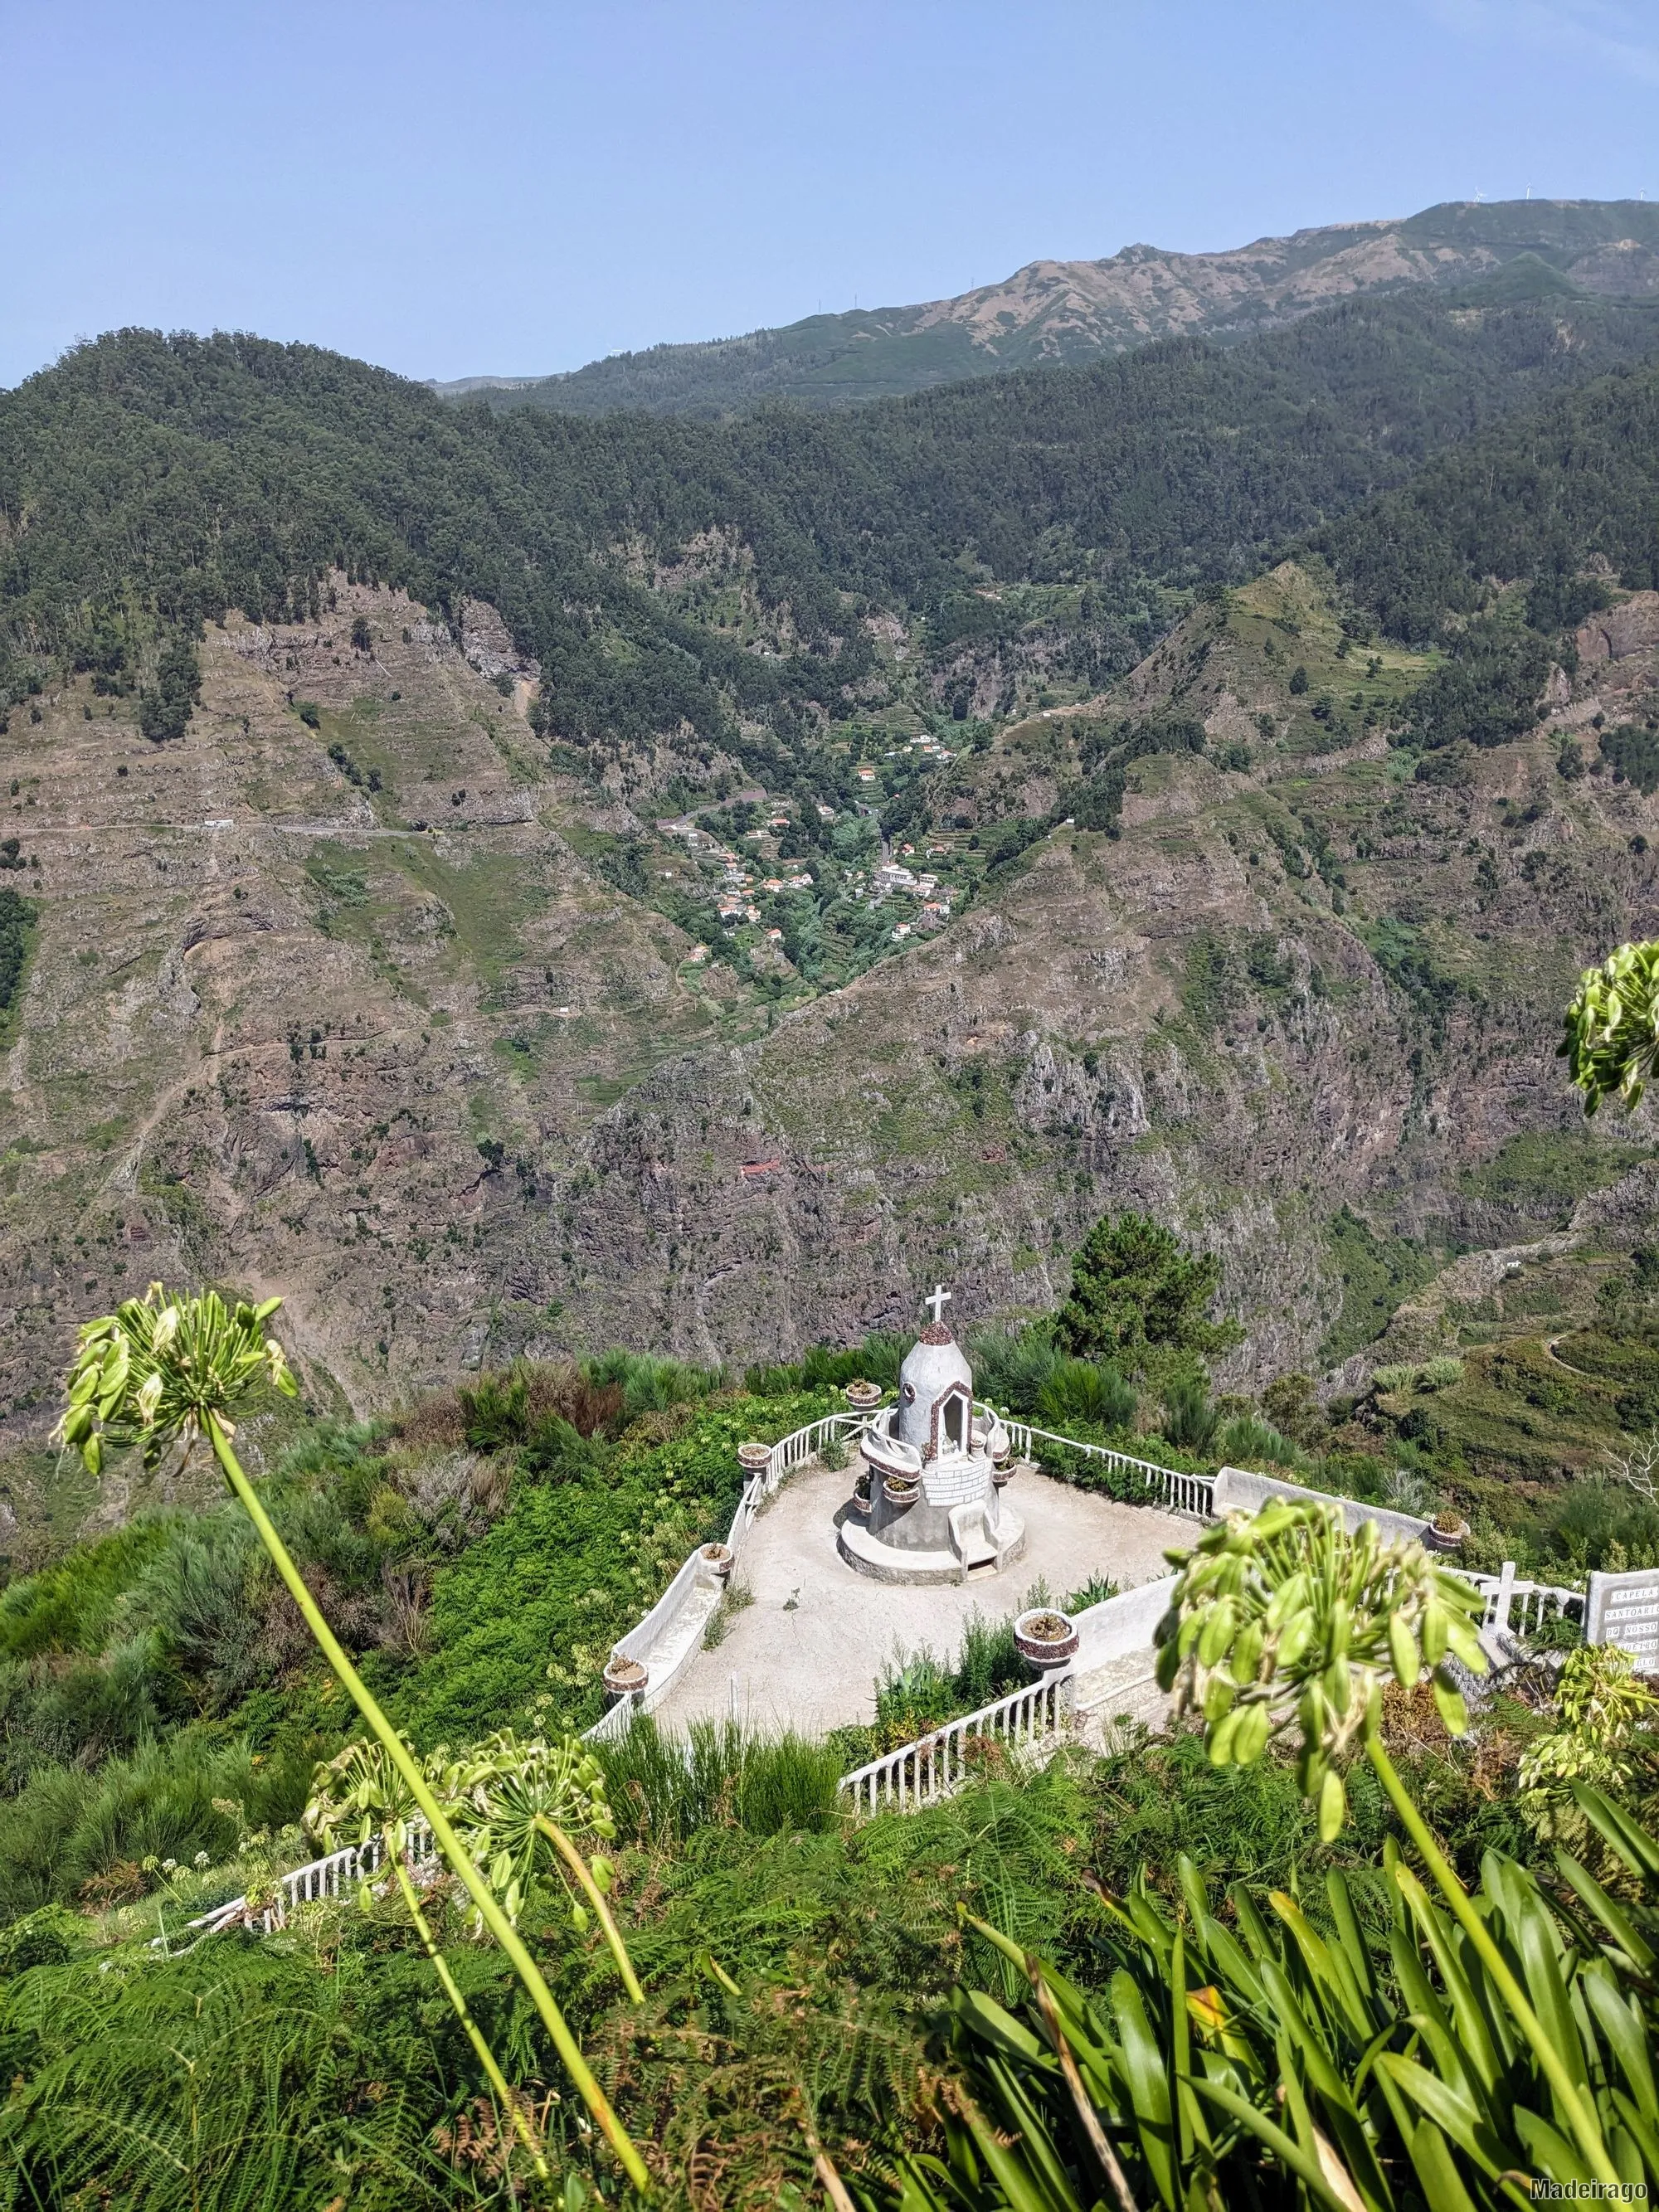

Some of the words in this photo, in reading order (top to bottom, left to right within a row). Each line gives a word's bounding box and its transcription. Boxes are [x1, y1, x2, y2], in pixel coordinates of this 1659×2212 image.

[1616, 1588, 1653, 1600] CAPELA
[1607, 1627, 1618, 1636] DO
[1627, 1623, 1657, 1633] NOSSO
